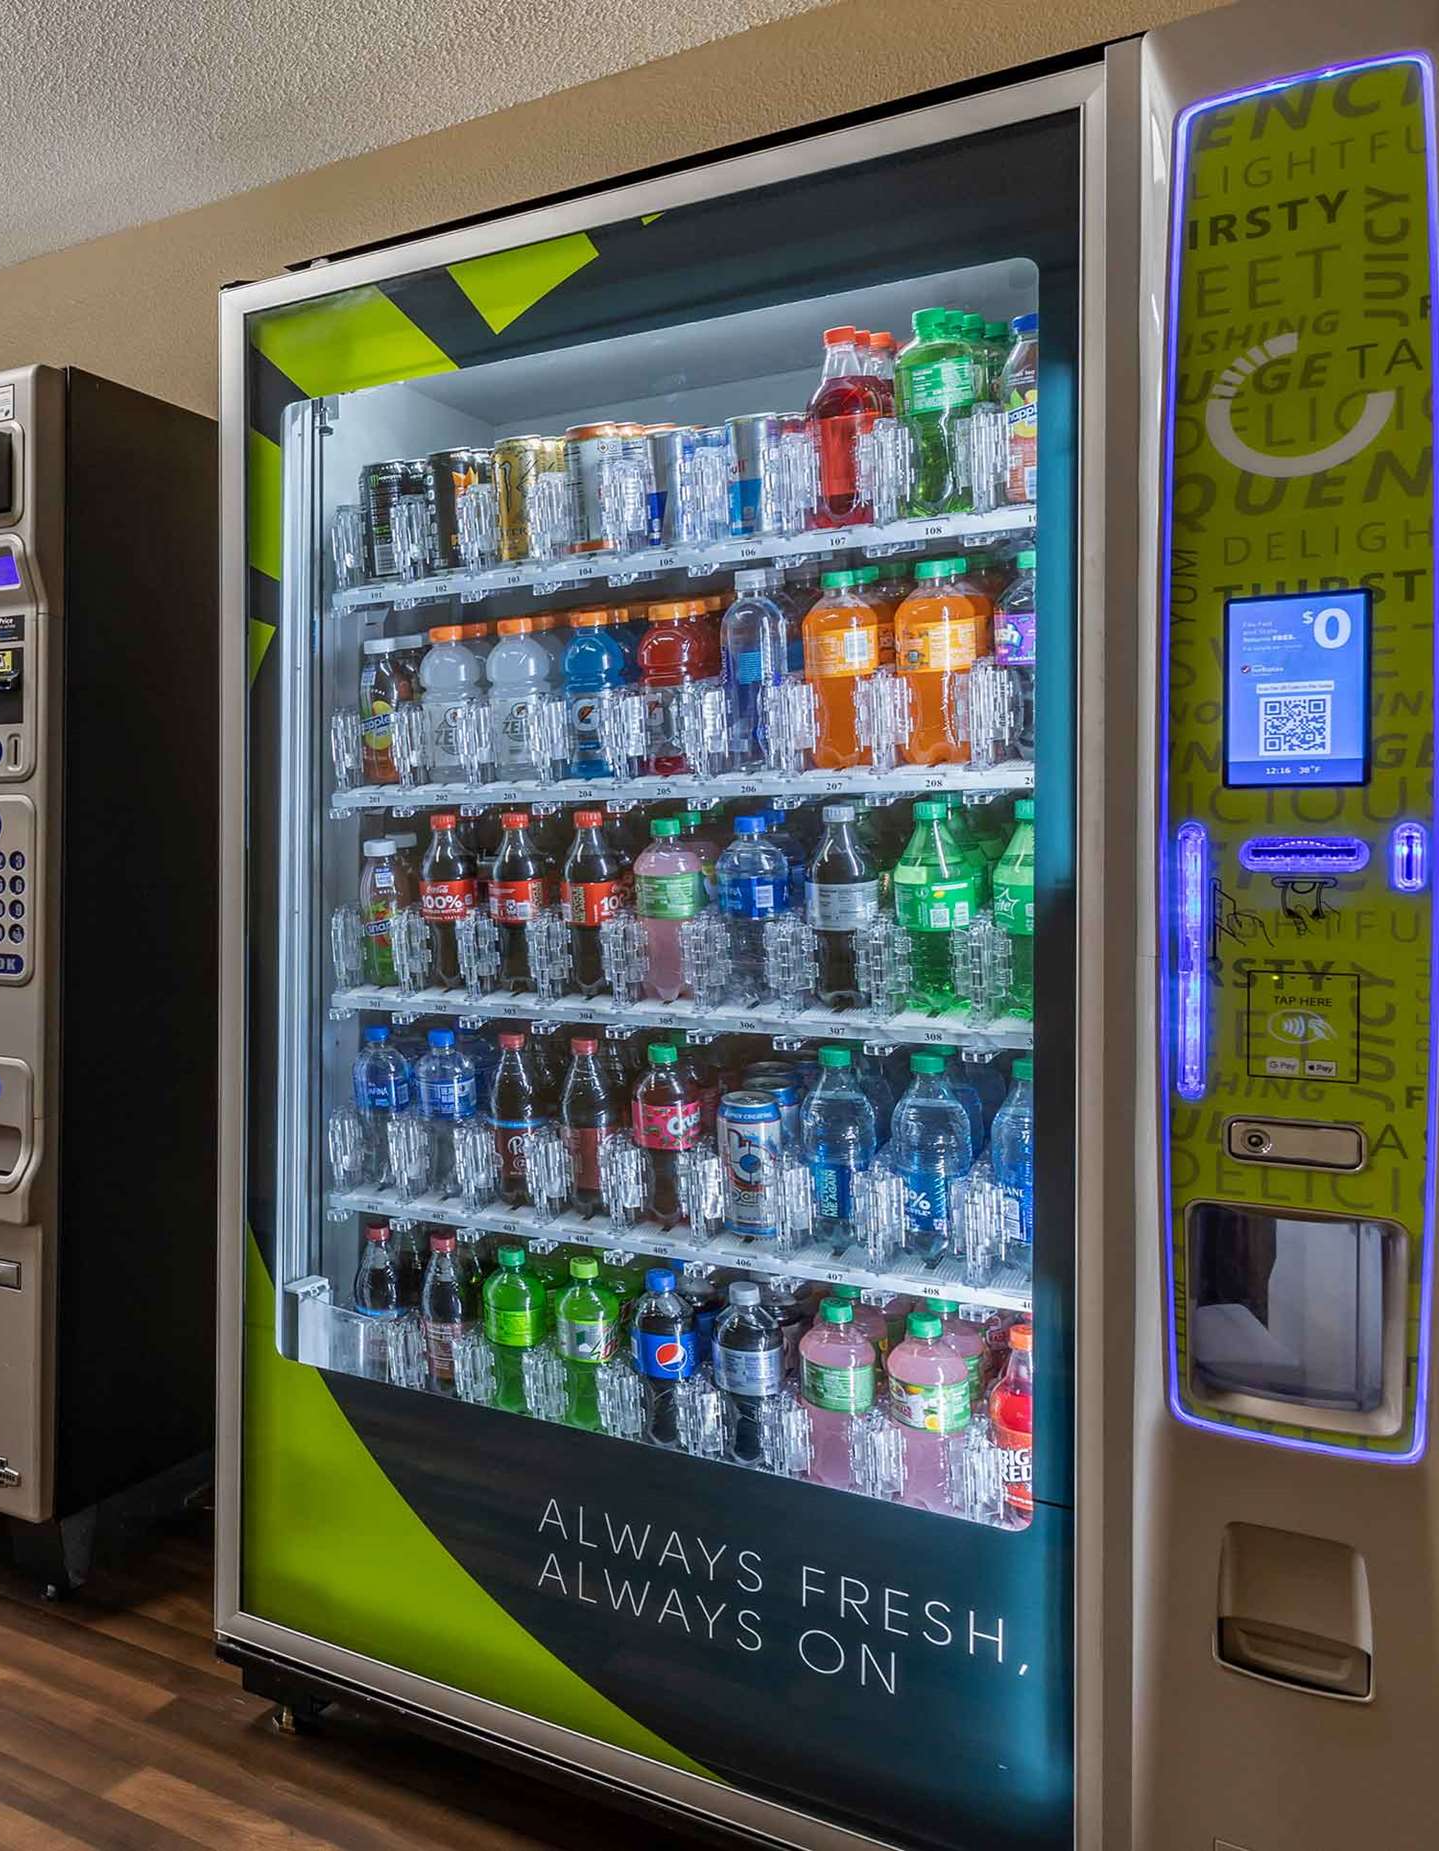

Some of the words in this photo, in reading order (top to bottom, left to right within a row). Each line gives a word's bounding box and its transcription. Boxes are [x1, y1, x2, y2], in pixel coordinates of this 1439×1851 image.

[1194, 68, 1424, 154] ENC
[1187, 189, 1349, 250] IRSTY
[1364, 185, 1410, 327] JUICY
[435, 585, 448, 593] 102
[579, 567, 593, 576] 104
[659, 558, 674, 567] 105
[740, 548, 757, 558] 106
[829, 536, 847, 547] 107
[924, 526, 943, 536] 108
[435, 794, 449, 802] 202
[578, 789, 593, 799] 204
[657, 787, 671, 797] 205
[740, 784, 757, 794] 206
[825, 782, 843, 792] 207
[925, 778, 944, 788] 208
[422, 894, 464, 909] 100%
[739, 1021, 756, 1030] 306
[828, 1026, 846, 1035] 307
[924, 1032, 943, 1041] 308
[1274, 995, 1296, 1005] TAP
[1299, 996, 1334, 1007] HERE
[735, 1259, 752, 1267] 406
[922, 1287, 940, 1296] 408
[538, 1497, 762, 1594] ALWAYS
[801, 1565, 1029, 1677] FRESH,
[537, 1553, 762, 1652] ALWAYS
[798, 1629, 896, 1696] ON
